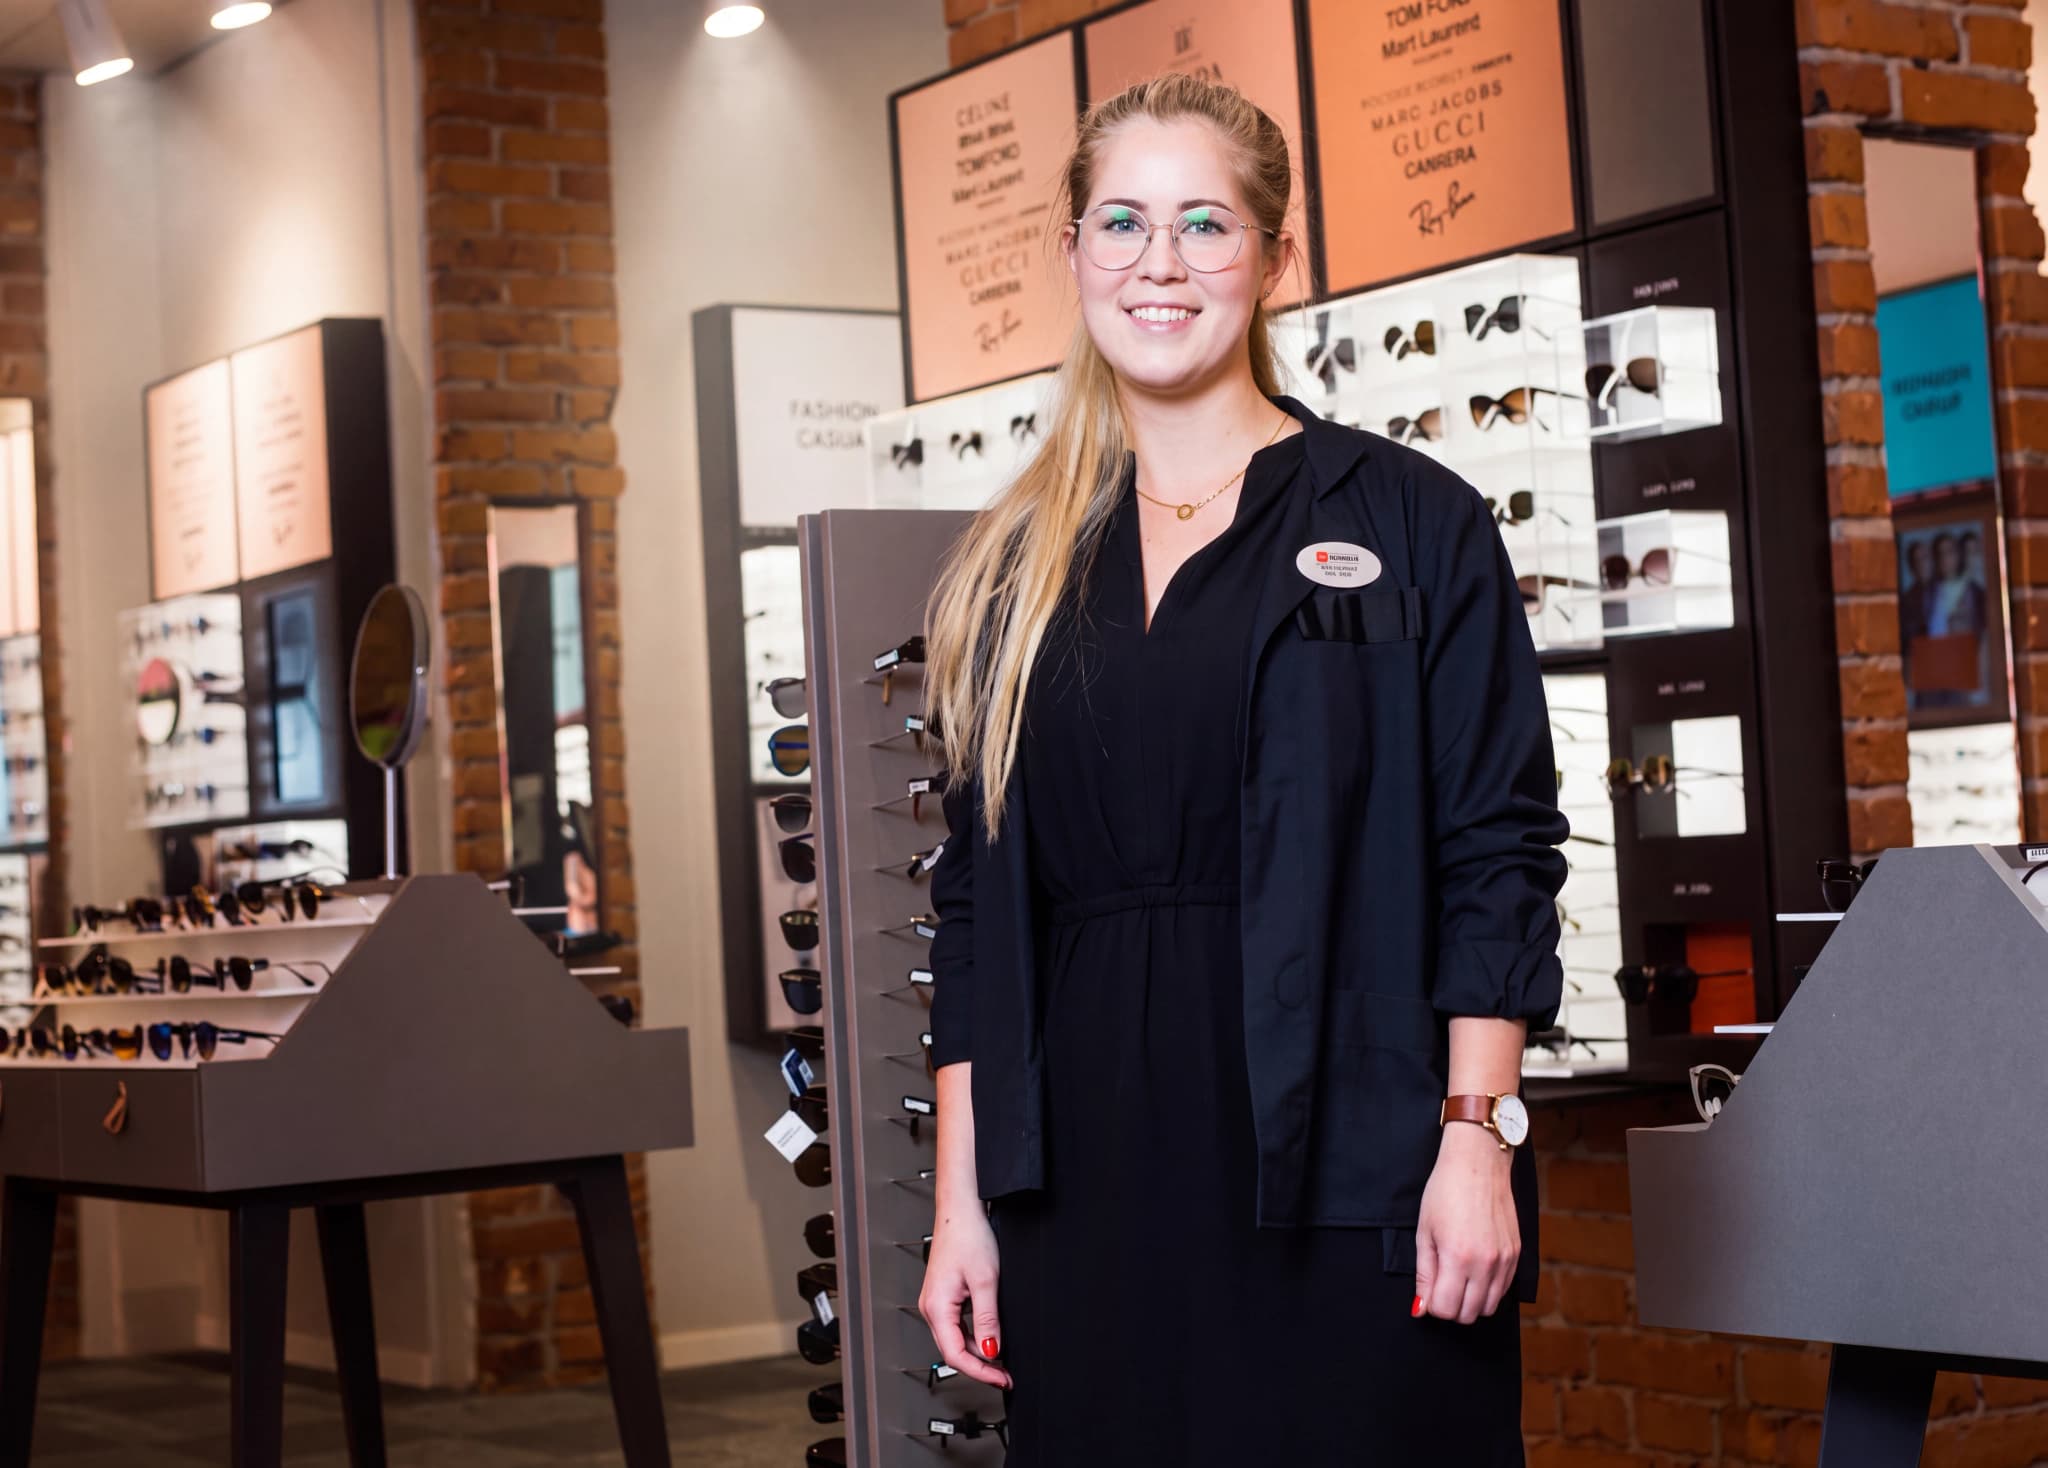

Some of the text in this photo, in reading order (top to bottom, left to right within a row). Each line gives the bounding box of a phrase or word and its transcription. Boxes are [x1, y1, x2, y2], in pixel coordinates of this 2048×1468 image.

[1385, 2, 1423, 29] TOM
[1371, 104, 1421, 131] MARC
[1430, 79, 1503, 116] JACOBS
[1393, 110, 1485, 157] GUCCI
[790, 400, 880, 421] FASHION
[797, 429, 865, 449] CASUA
